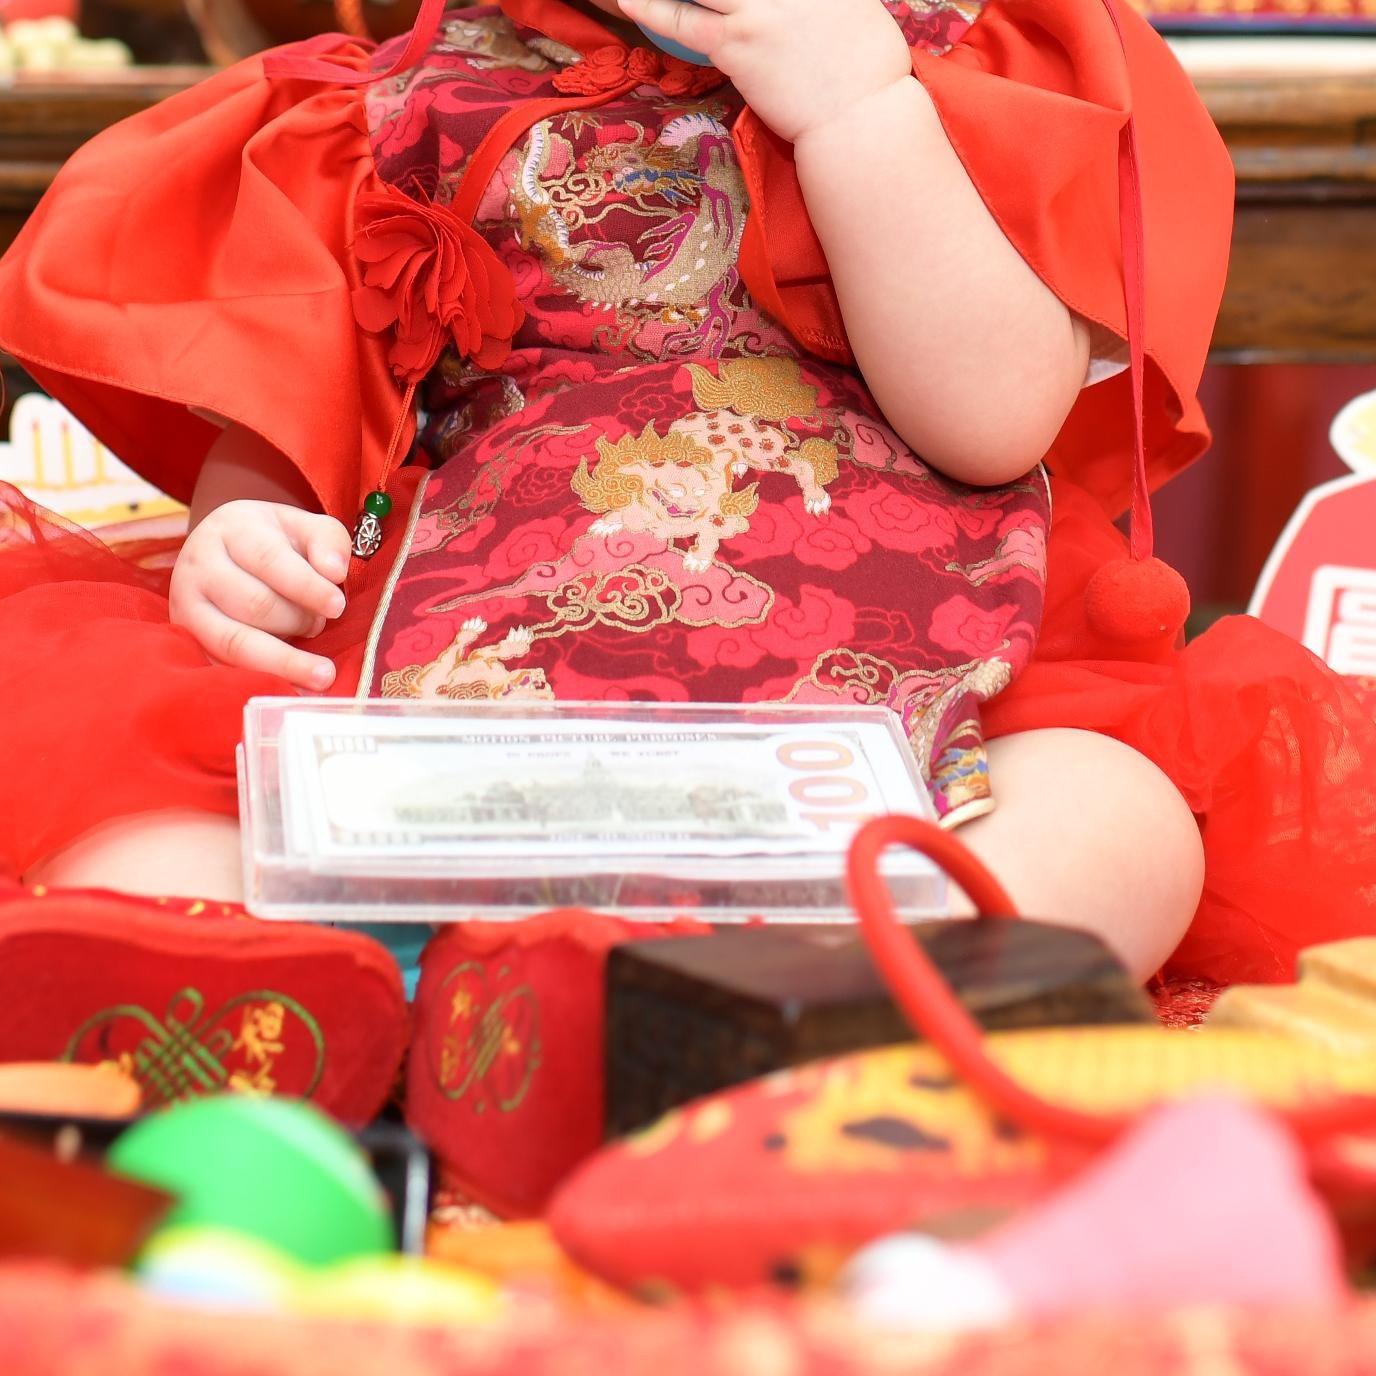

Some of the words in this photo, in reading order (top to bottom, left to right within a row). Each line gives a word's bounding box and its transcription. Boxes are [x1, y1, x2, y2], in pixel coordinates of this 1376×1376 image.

[461, 733, 531, 745] MOTION
[538, 733, 617, 744] PICTURE
[775, 740, 876, 833] 100
